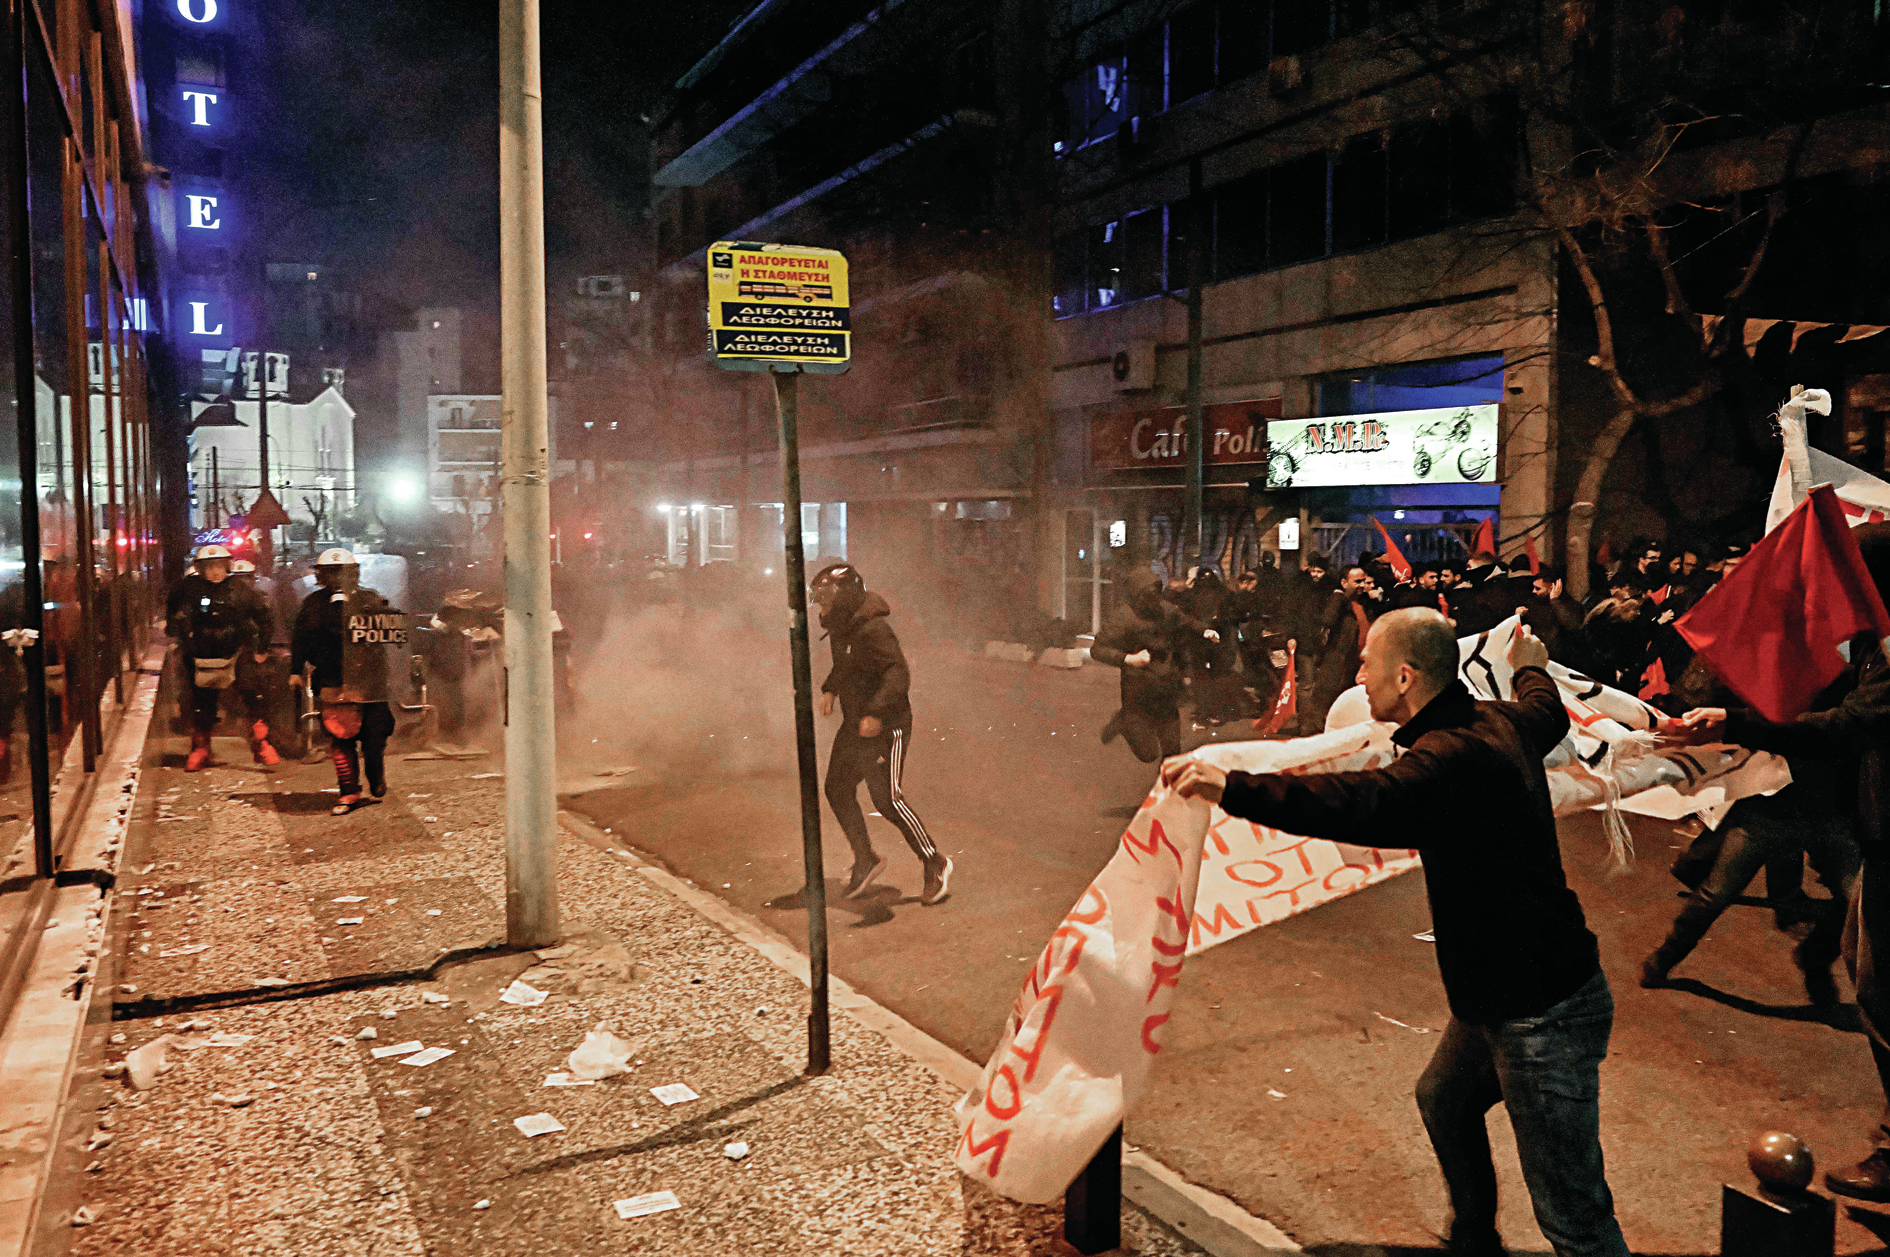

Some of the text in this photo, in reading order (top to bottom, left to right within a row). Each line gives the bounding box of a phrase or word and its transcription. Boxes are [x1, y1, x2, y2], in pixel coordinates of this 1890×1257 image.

[739, 254, 829, 270] ΑΠΑΓΟΡΕΥΕΤΑΙ
[740, 269, 830, 283] Η ΣΤΑΘΜΕΥΣΗ
[739, 306, 835, 318] ΔΙΕΛΕΥΣΗ
[729, 316, 843, 327] ΛΕΩΦΟΡΕΙΩΝ
[734, 334, 830, 345] ΔΙΕΛΕΥΣΗ
[723, 343, 839, 355] ΛΕΩΦΟΡΕΙΩΝ
[1130, 414, 1269, 460] Caf Poli
[351, 629, 408, 644] POLICE
